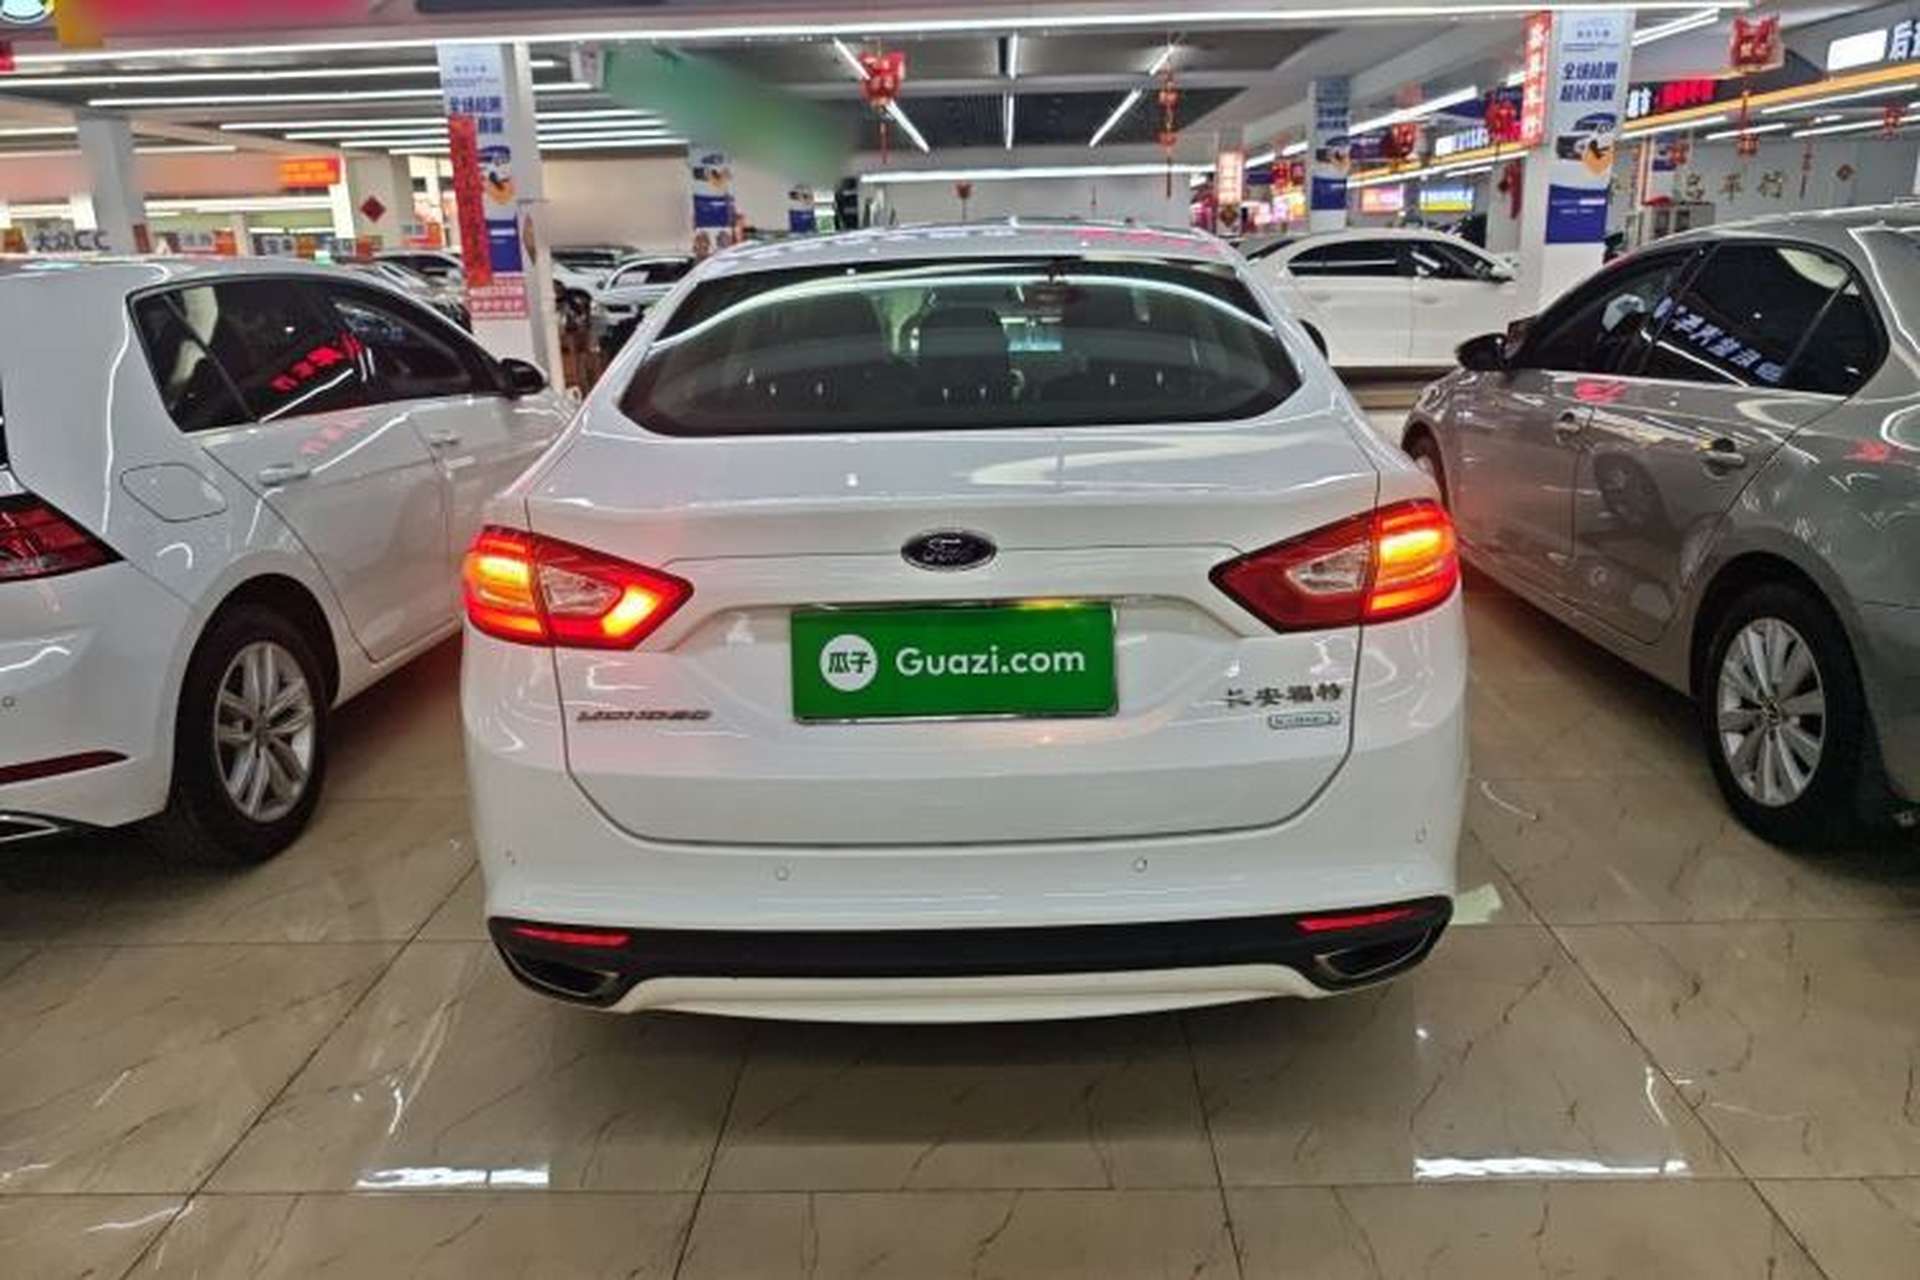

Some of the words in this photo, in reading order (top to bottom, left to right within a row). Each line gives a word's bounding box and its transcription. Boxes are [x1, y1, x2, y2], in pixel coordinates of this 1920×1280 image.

[827, 651, 872, 675] 瓜子
[895, 646, 1086, 678] Guazi.com
[1223, 681, 1344, 709] 长安福特
